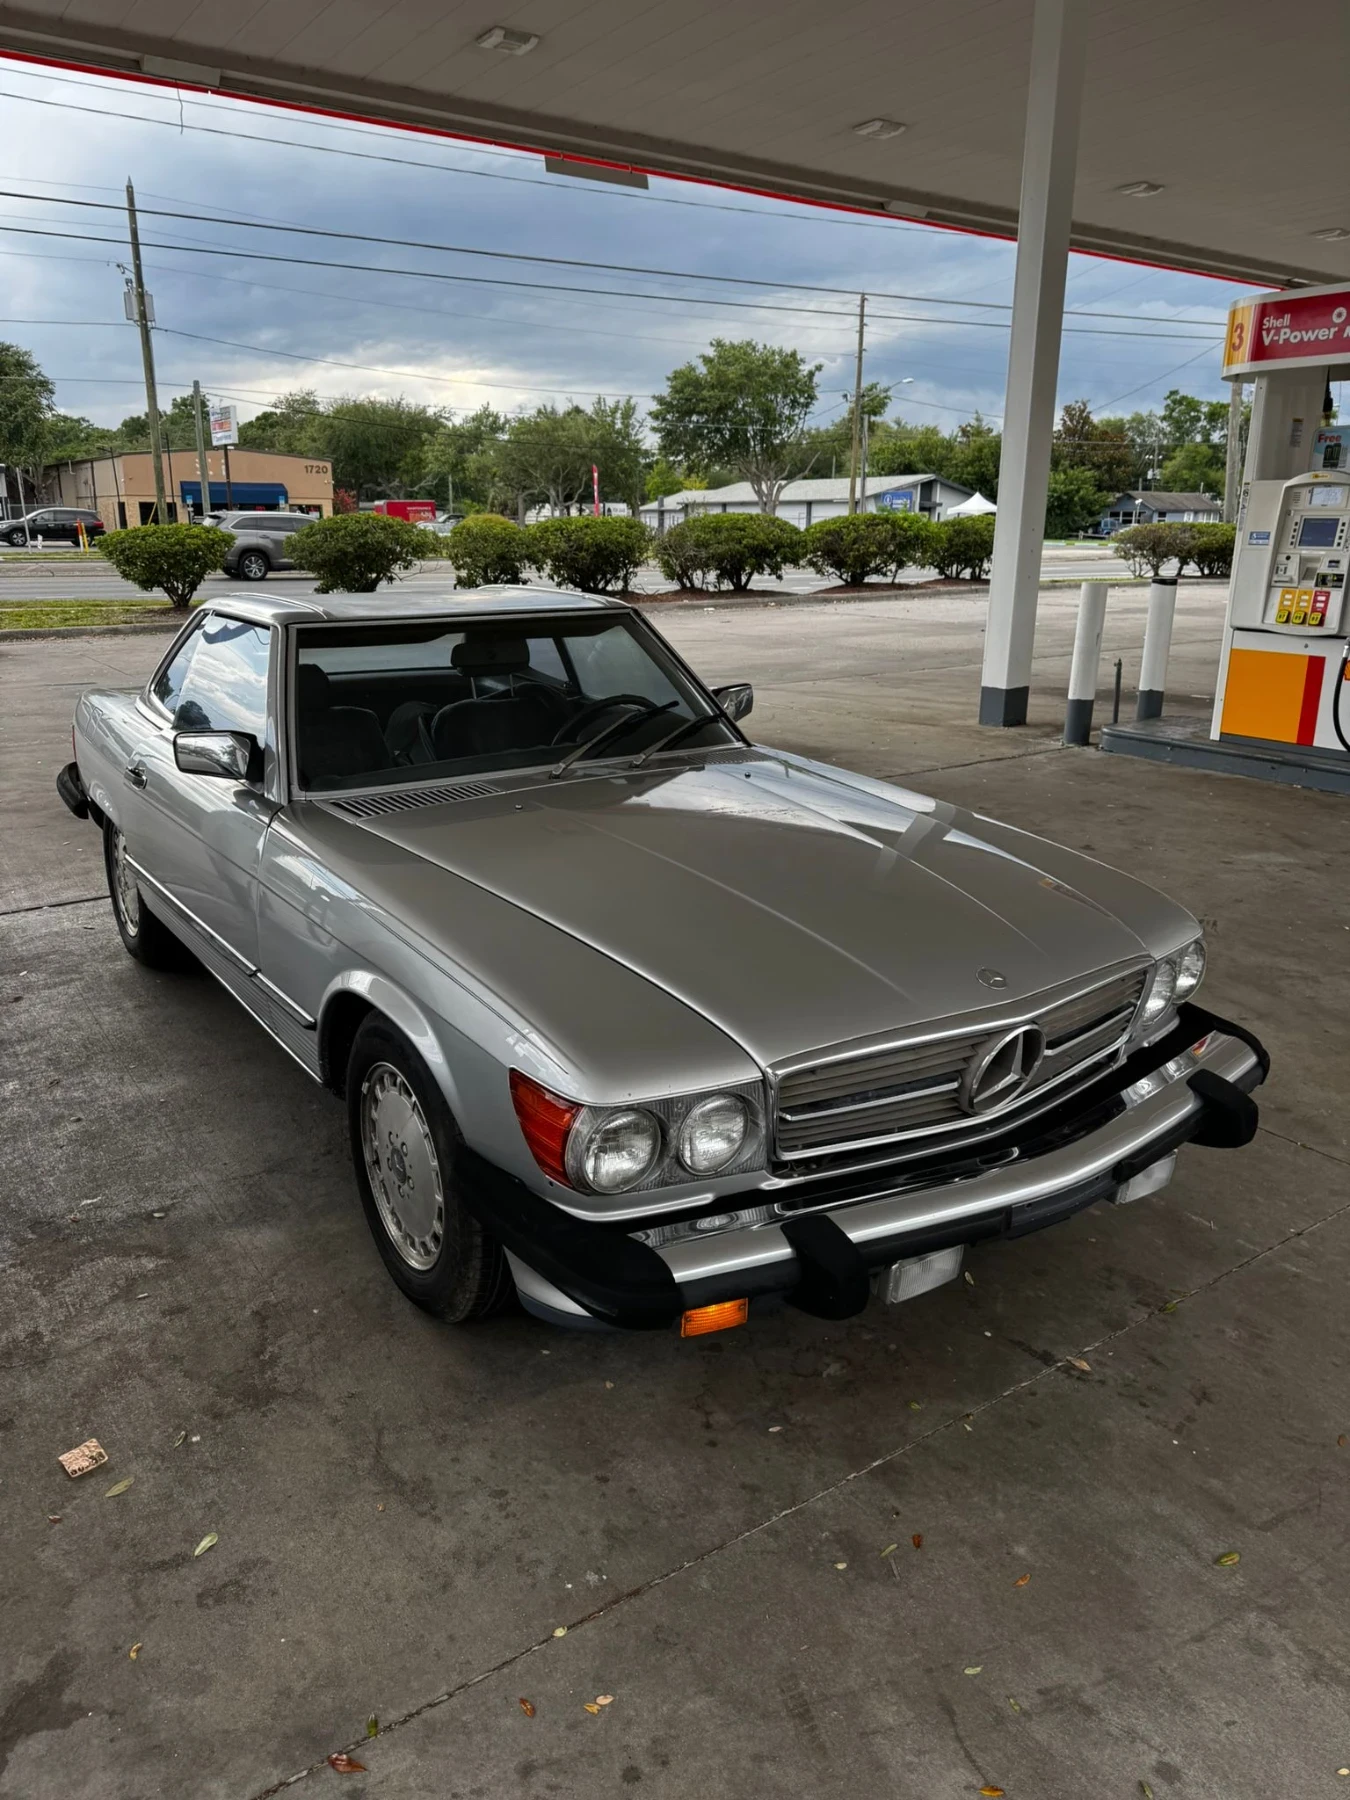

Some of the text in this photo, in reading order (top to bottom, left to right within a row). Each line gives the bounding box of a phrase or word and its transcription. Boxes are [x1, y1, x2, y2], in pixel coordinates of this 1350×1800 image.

[1262, 313, 1291, 329] Shell
[1231, 322, 1245, 352] 3
[1261, 326, 1339, 346] V-Power
[1317, 433, 1342, 443] Free
[304, 464, 328, 474] 1720
